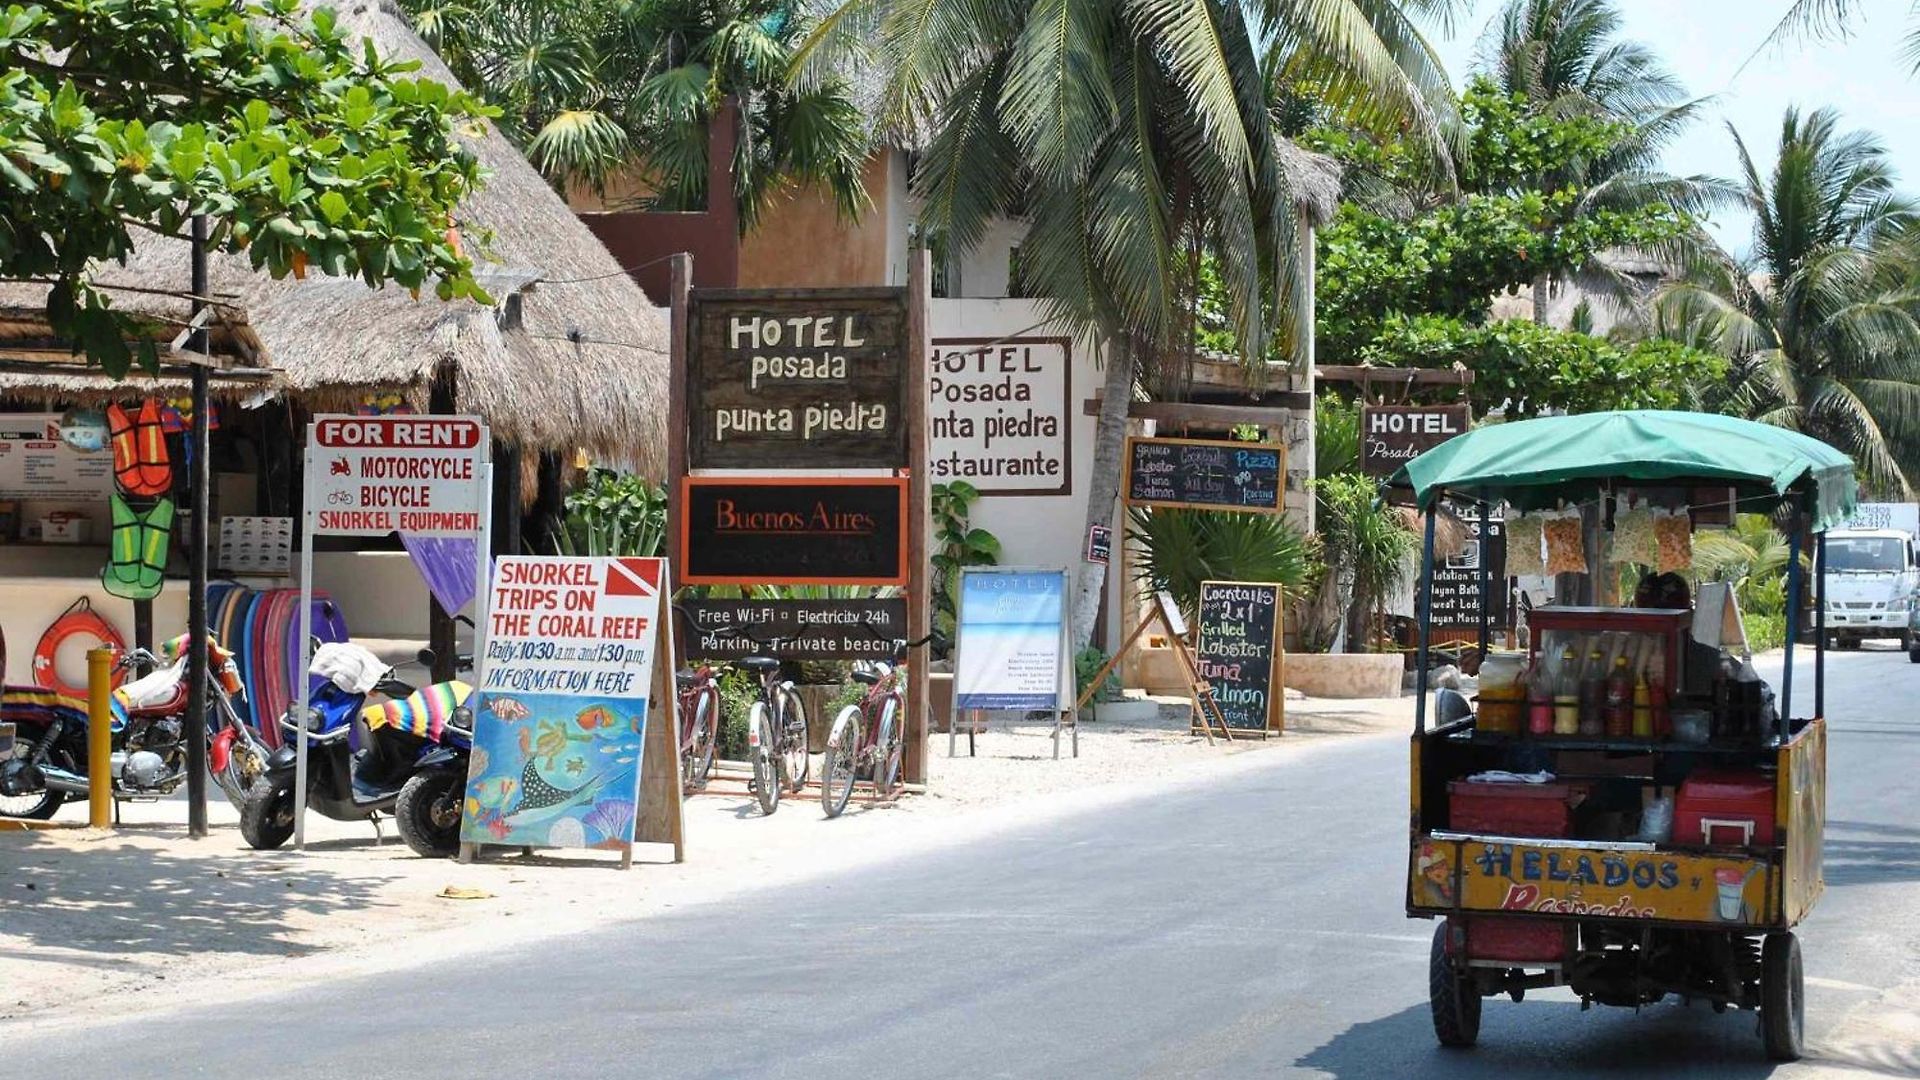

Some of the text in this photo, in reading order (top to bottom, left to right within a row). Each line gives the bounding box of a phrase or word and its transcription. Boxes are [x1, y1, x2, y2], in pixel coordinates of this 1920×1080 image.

[730, 316, 865, 349] HOTEL
[751, 352, 846, 389] posada
[931, 375, 1031, 402] Posada
[716, 401, 886, 441] punta piedra
[933, 408, 1057, 448] nta piedra
[1371, 413, 1457, 433] HOTEL
[324, 423, 472, 445] FOR RENT
[1369, 441, 1419, 458] Posada
[361, 457, 472, 480] MOTORCYCLE
[930, 451, 1059, 476] staurante
[361, 486, 430, 507] BICYCLE
[319, 511, 479, 532] SNORKEL EQUIPMENT
[716, 499, 876, 530] Buenos Aires
[501, 563, 599, 585] SNORKEL
[496, 588, 595, 611] TRIPS ON
[1203, 585, 1274, 605] Cocktails
[492, 614, 648, 639] THE CORAL REEF
[698, 608, 890, 624] Free Wi-Fi Electricity 24h
[1201, 621, 1246, 637] Grilled
[701, 637, 759, 653] Parking
[1199, 637, 1267, 658] Lobster
[486, 668, 635, 694] INFORMATION HERE
[1196, 660, 1242, 682] Tuna
[1475, 844, 1679, 890] HELADOS
